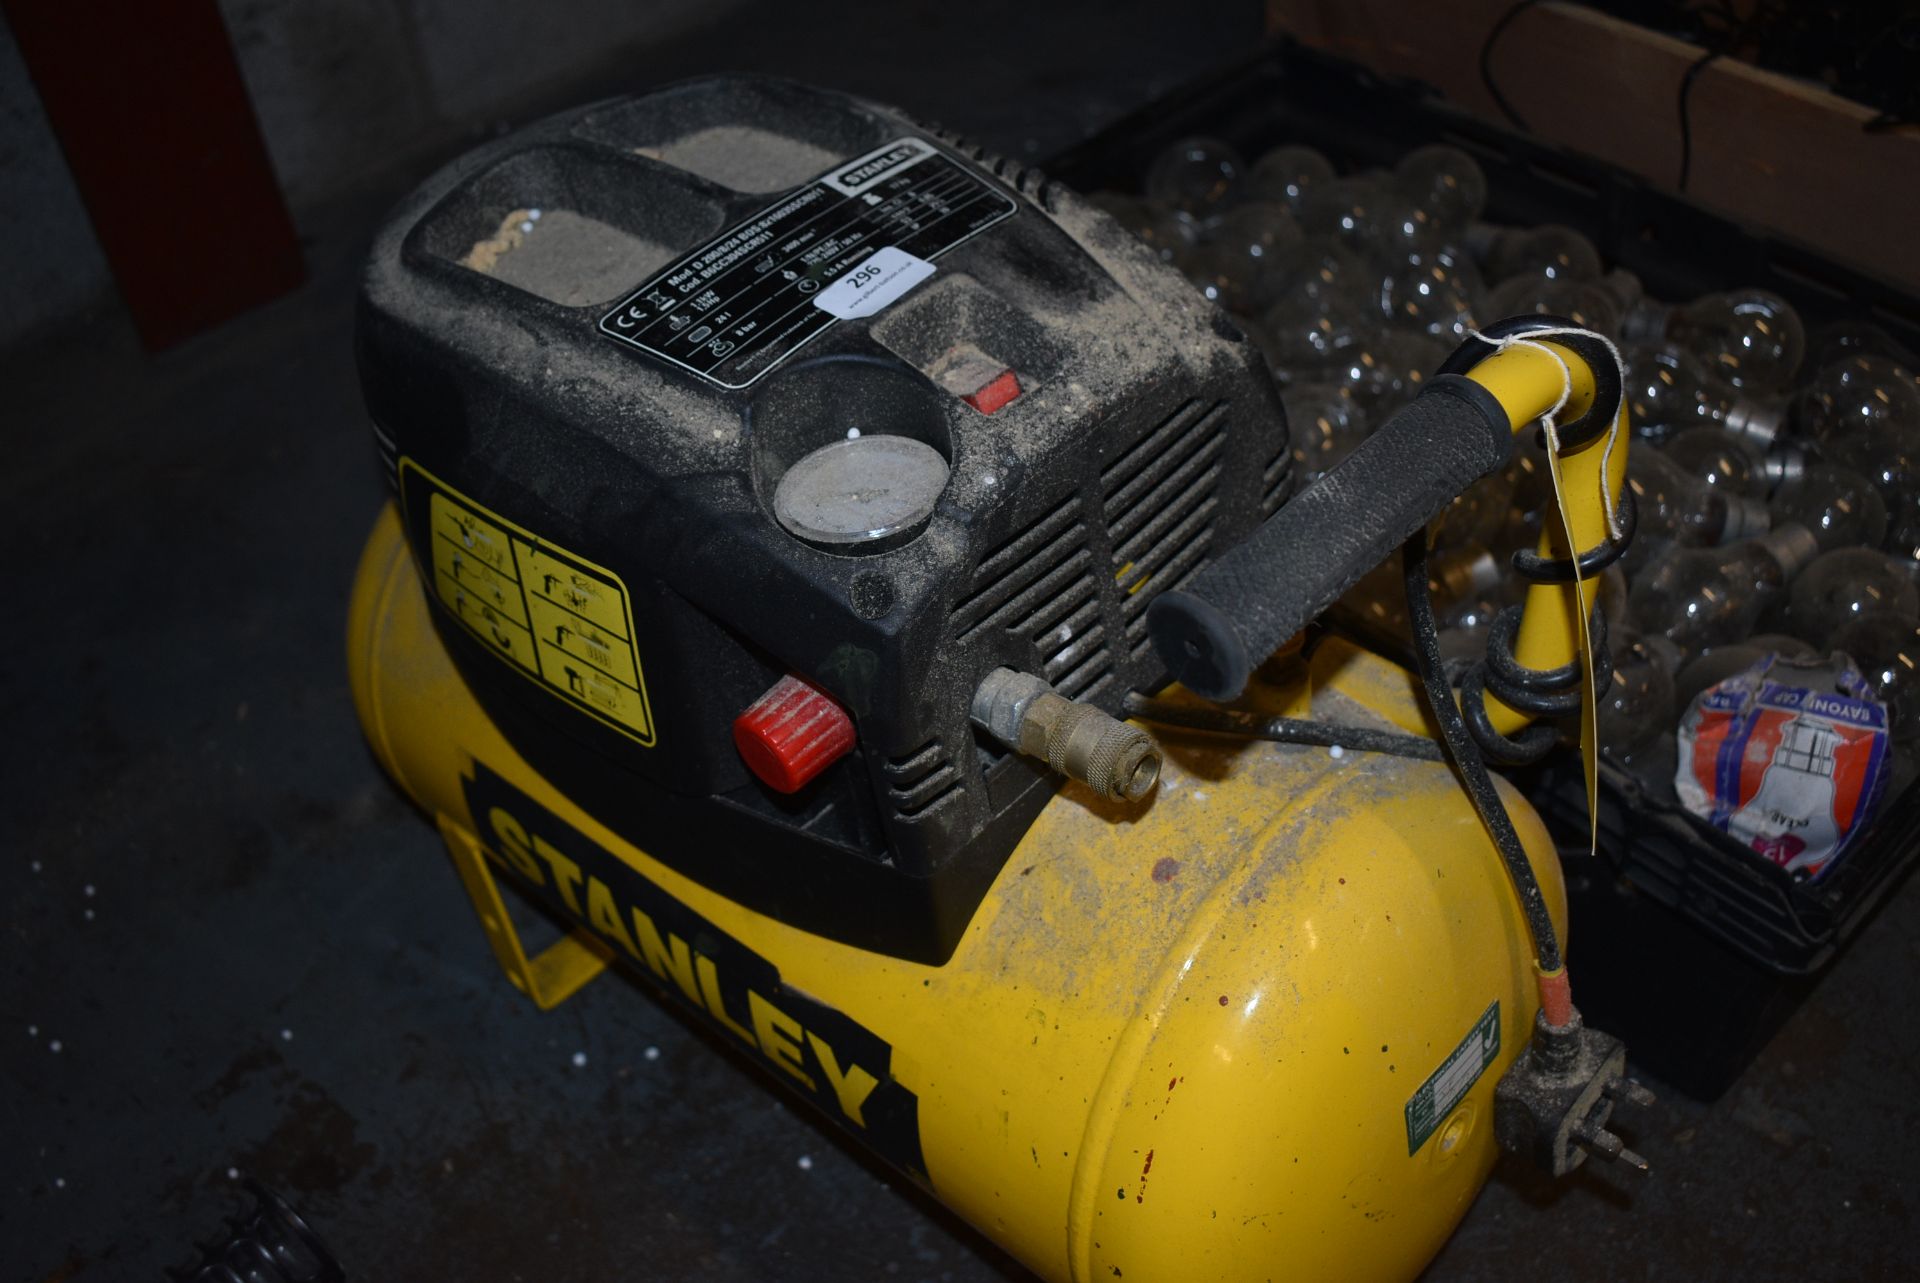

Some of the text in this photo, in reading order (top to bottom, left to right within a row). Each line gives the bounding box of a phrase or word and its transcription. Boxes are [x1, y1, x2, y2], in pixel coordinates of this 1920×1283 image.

[843, 147, 912, 184] STANLEY
[678, 277, 704, 293] Cod.
[846, 264, 881, 288] 296
[488, 805, 880, 1129] STANLEY
